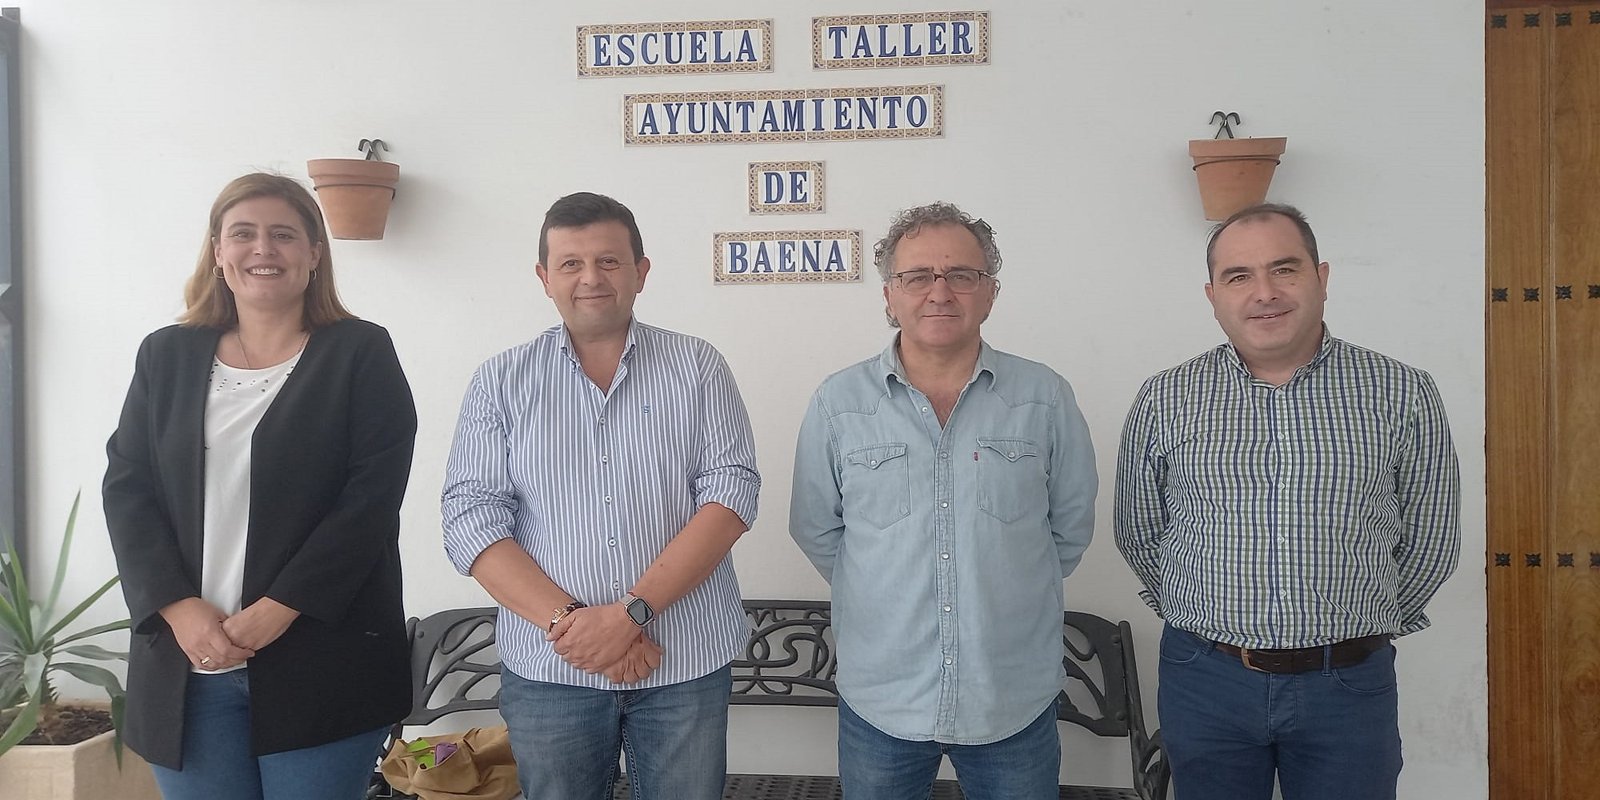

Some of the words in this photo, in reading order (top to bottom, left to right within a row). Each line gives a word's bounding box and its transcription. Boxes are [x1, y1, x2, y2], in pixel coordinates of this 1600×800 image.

[592, 29, 758, 67] ESCUELA
[828, 21, 974, 59] TALLER
[638, 95, 928, 135] AYUNTAMIENTO
[764, 171, 808, 204] DE
[728, 240, 846, 274] BAENA
